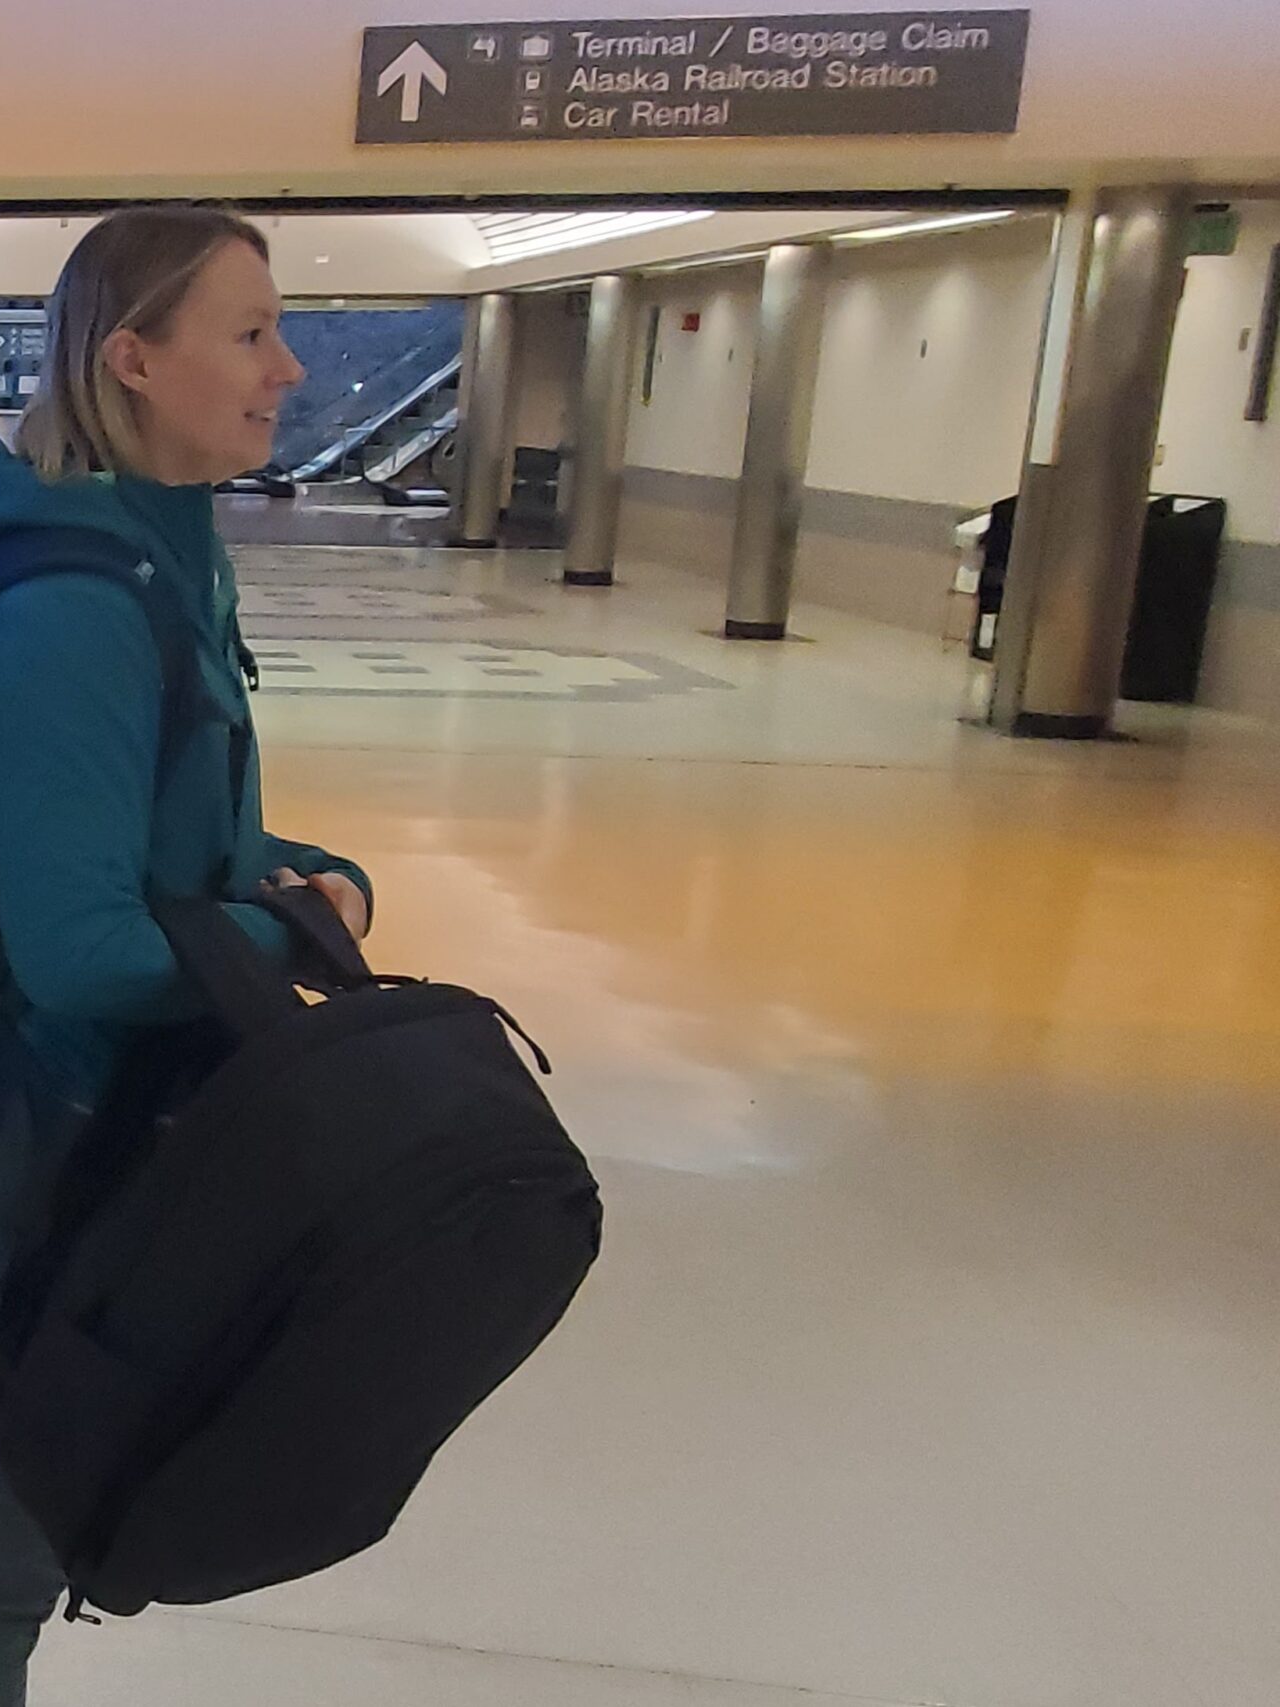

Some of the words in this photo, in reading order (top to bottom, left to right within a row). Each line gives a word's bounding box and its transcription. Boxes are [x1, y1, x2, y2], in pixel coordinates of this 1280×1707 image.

[572, 30, 696, 57] Terminal
[708, 26, 733, 57] /
[747, 26, 888, 58] Baggage
[901, 22, 989, 50] Claim
[567, 66, 670, 93] Alaska
[684, 63, 811, 91] Railroad
[824, 60, 938, 88] Station
[563, 101, 619, 128] Car
[630, 99, 730, 127] Rental
